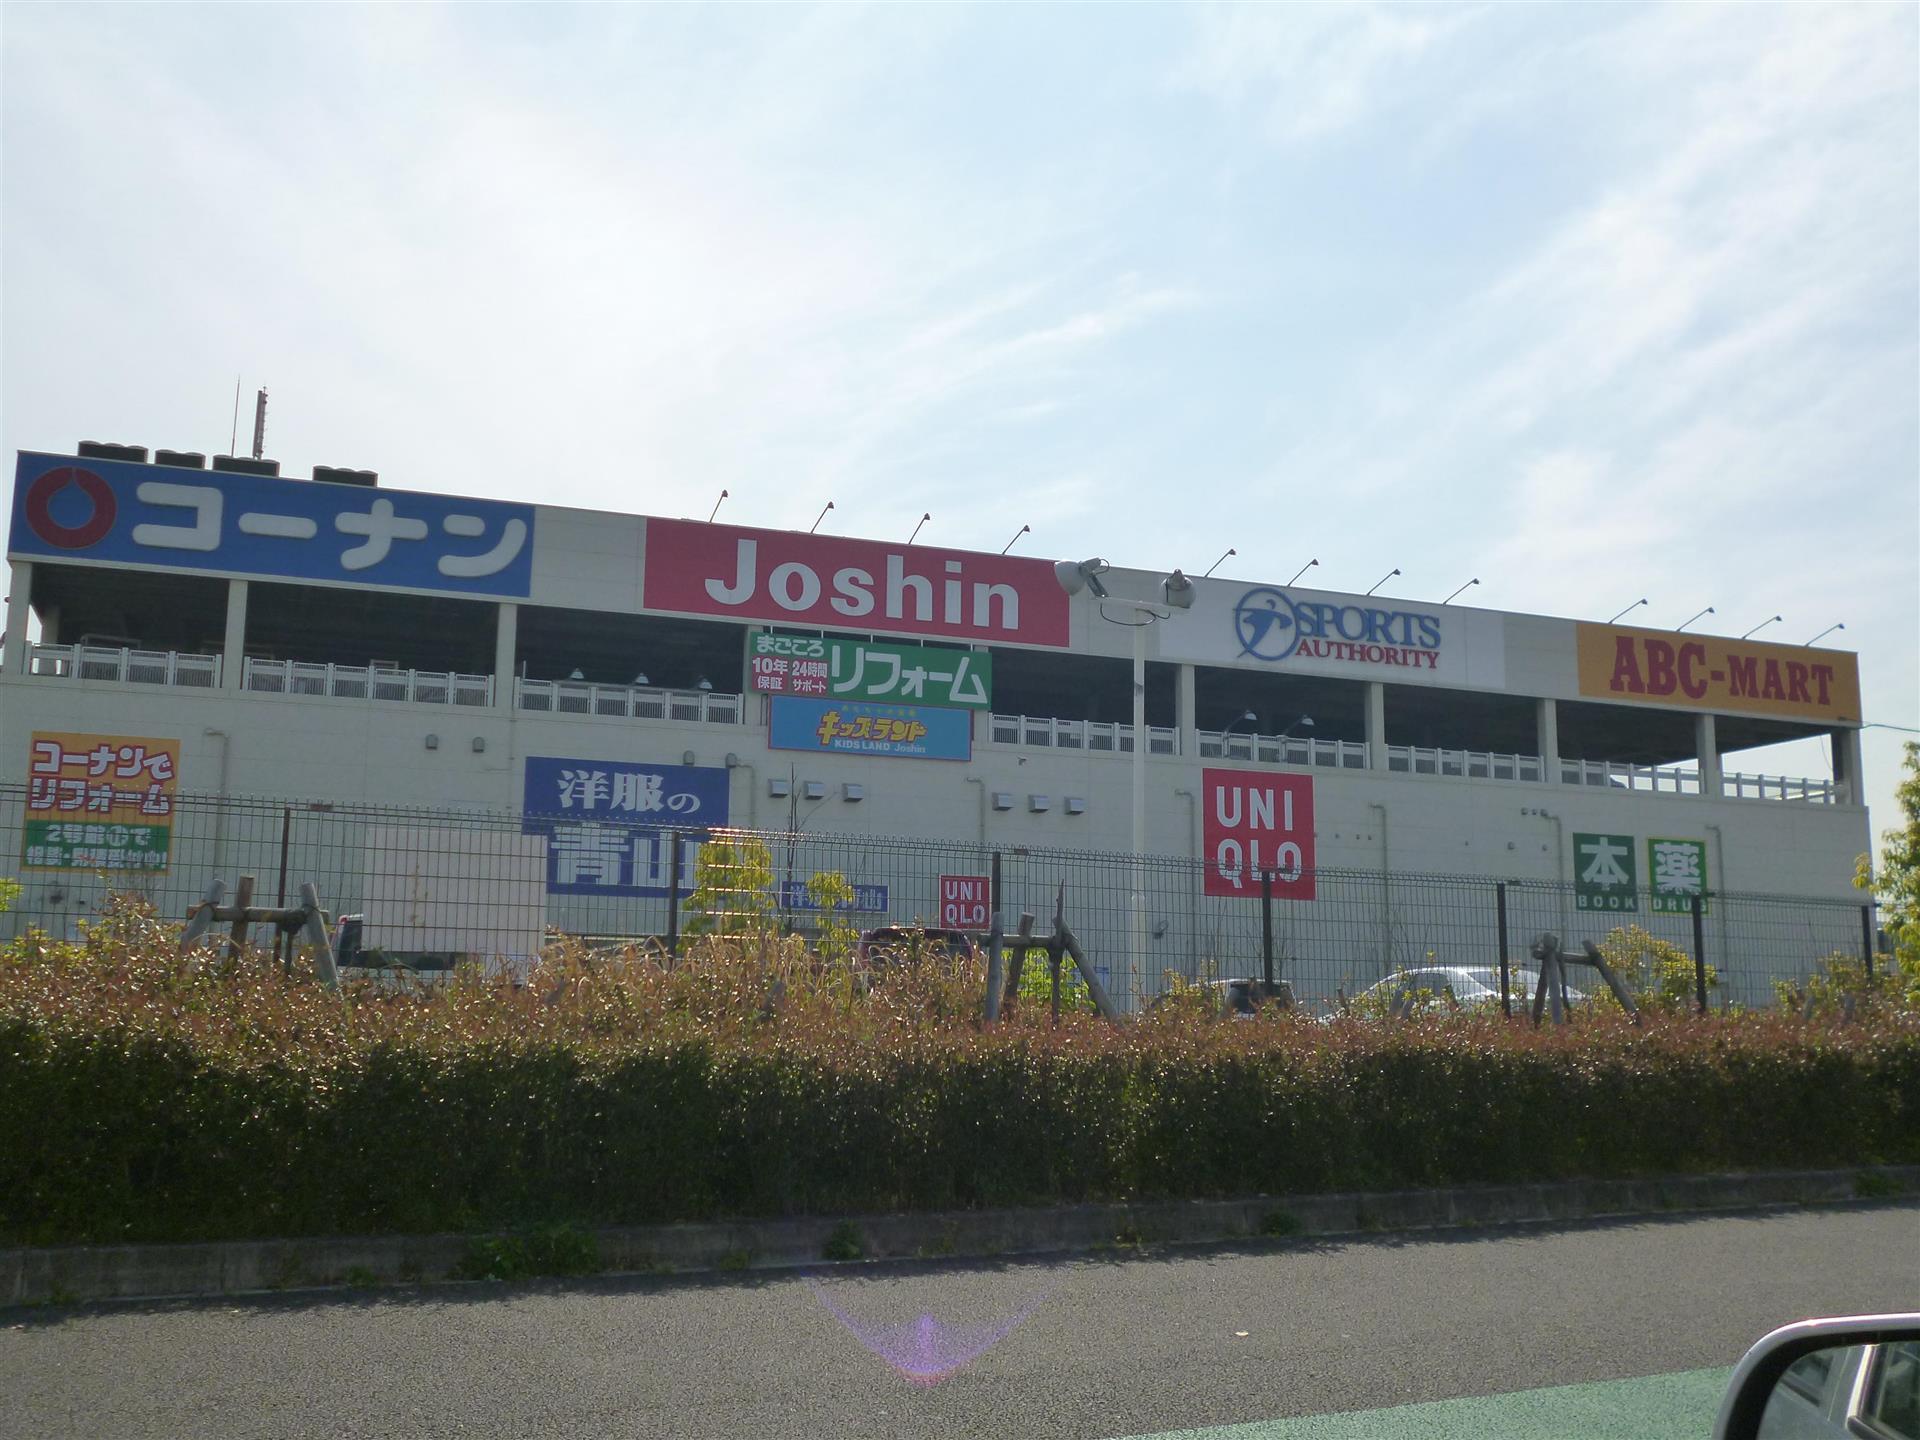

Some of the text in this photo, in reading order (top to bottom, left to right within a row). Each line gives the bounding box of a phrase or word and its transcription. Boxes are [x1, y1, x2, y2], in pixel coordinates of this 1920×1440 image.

[132, 481, 527, 577] コーナン
[704, 538, 1019, 630] Joshin
[1294, 601, 1441, 650] SPORTS
[752, 657, 789, 675] 10年
[756, 635, 825, 658] まごころ
[1295, 638, 1441, 669] AUTHORITY
[757, 675, 784, 690] 保証
[791, 660, 829, 678] 24時間
[792, 679, 828, 694] サポート
[831, 644, 988, 704] リフォーム
[1609, 635, 1834, 706] ABC-MART
[818, 709, 927, 745] キッズランド
[834, 739, 926, 753] KIDS LAND Joshin
[32, 740, 174, 781] コーナンで
[29, 777, 171, 815] リフォーム
[557, 769, 700, 814] 洋服の
[1216, 785, 1293, 831] UNI
[551, 822, 701, 889] 青山
[1217, 838, 1302, 888] QLO
[1581, 836, 1629, 891] 本
[1654, 842, 1701, 895] 薬
[945, 880, 982, 901] UNI
[1578, 895, 1635, 909] BOOK
[946, 903, 985, 927] QLO
